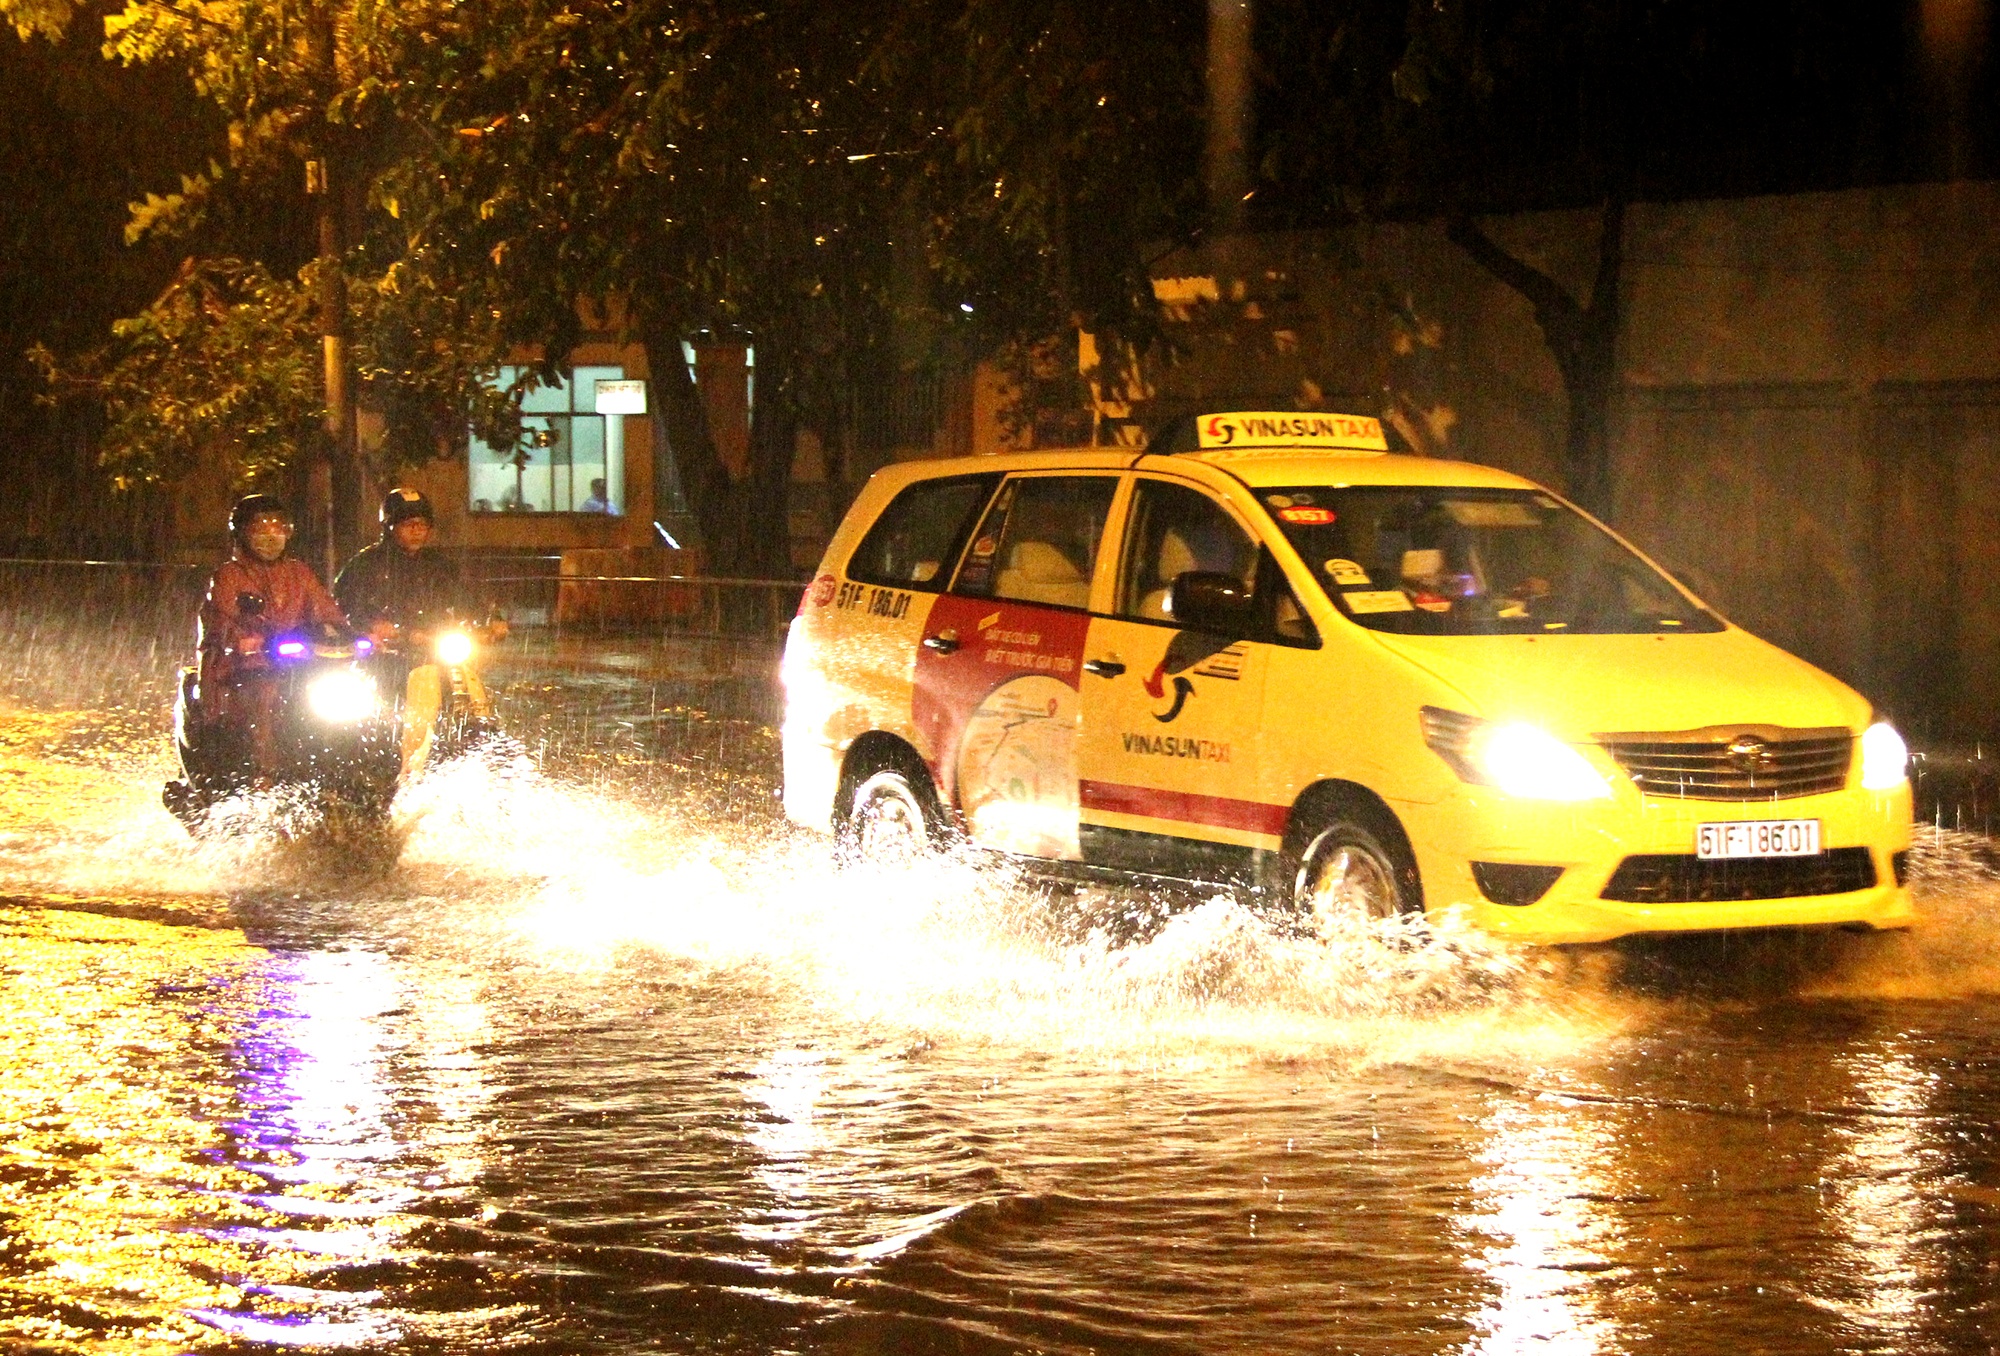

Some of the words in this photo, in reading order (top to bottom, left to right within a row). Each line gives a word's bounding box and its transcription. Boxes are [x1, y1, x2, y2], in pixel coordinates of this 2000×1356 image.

[1240, 419, 1334, 437] VINASUN
[1336, 419, 1380, 438] TAXI
[837, 582, 864, 610] 51F
[867, 588, 912, 619] 186.01
[1701, 823, 1811, 855] 51F-186.01
